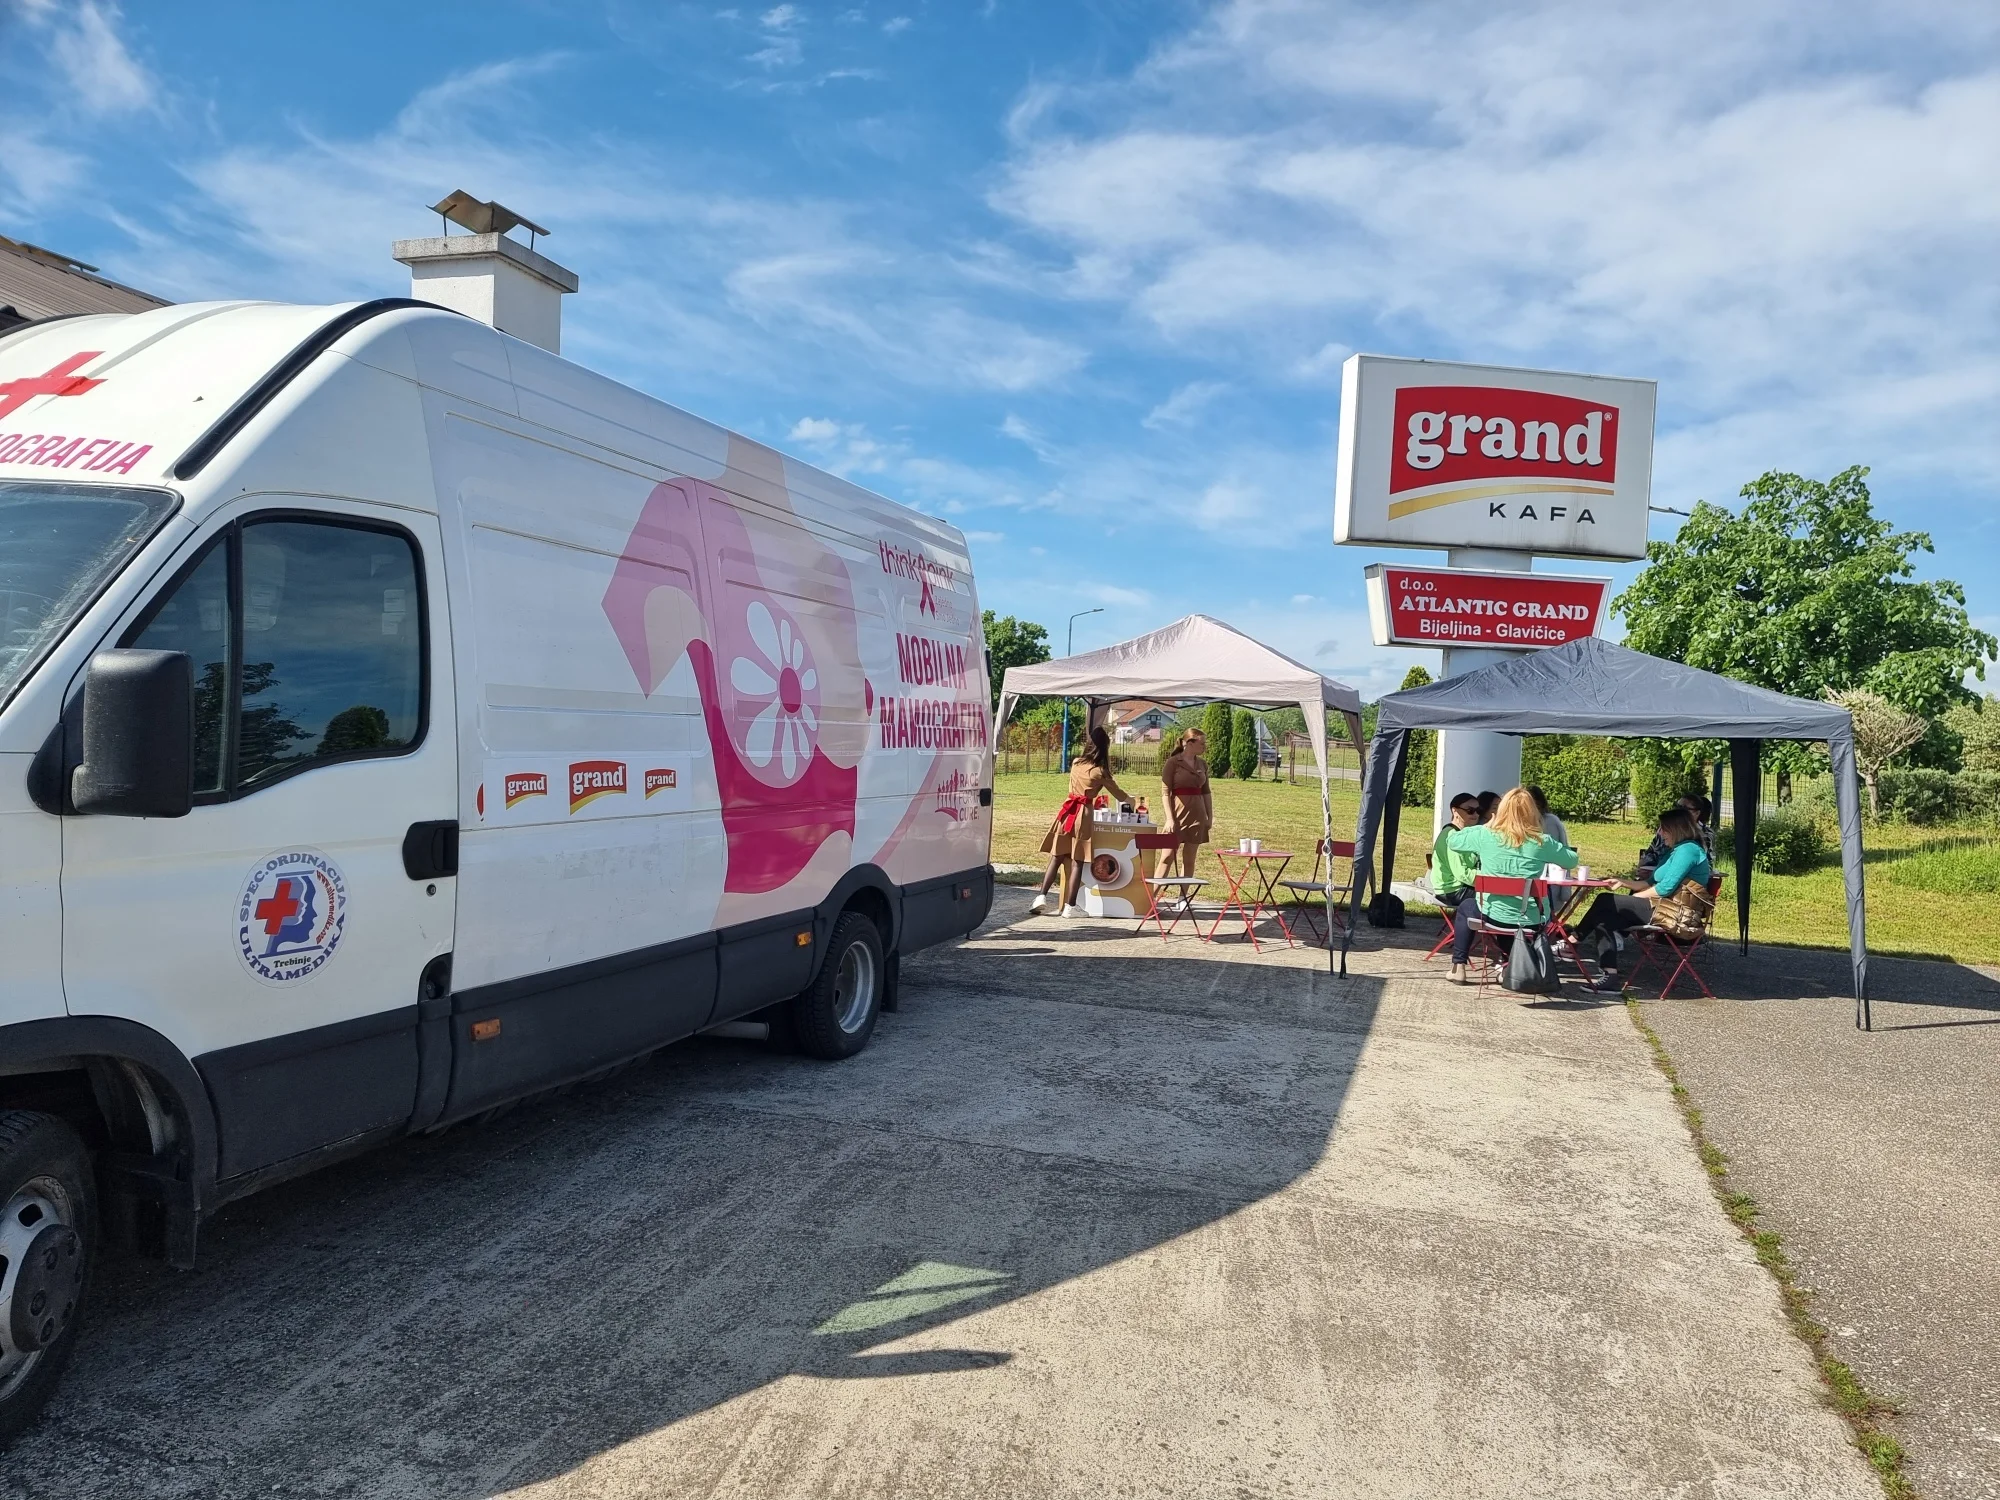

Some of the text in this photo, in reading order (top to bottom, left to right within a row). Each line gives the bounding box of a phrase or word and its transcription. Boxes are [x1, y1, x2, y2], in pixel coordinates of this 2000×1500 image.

[1405, 410, 1603, 470] grand
[0, 433, 154, 475] OGRAFIJA
[1489, 502, 1596, 525] KAFA
[879, 539, 920, 582] think
[1399, 577, 1438, 592] d.o.o.
[1399, 595, 1590, 621] ATLANTIC GRAND
[1420, 618, 1482, 638] Bijeljina
[1496, 623, 1566, 641] Glavičice
[896, 632, 968, 690] MOBILNA
[879, 696, 987, 749] MAMOGRAFIJA
[507, 776, 546, 797] grand
[572, 765, 625, 795] grand
[646, 771, 675, 788] grand
[959, 772, 979, 788] RACE
[239, 911, 346, 981] ULTRAMEDIKA
[273, 956, 312, 968] Trebinje
